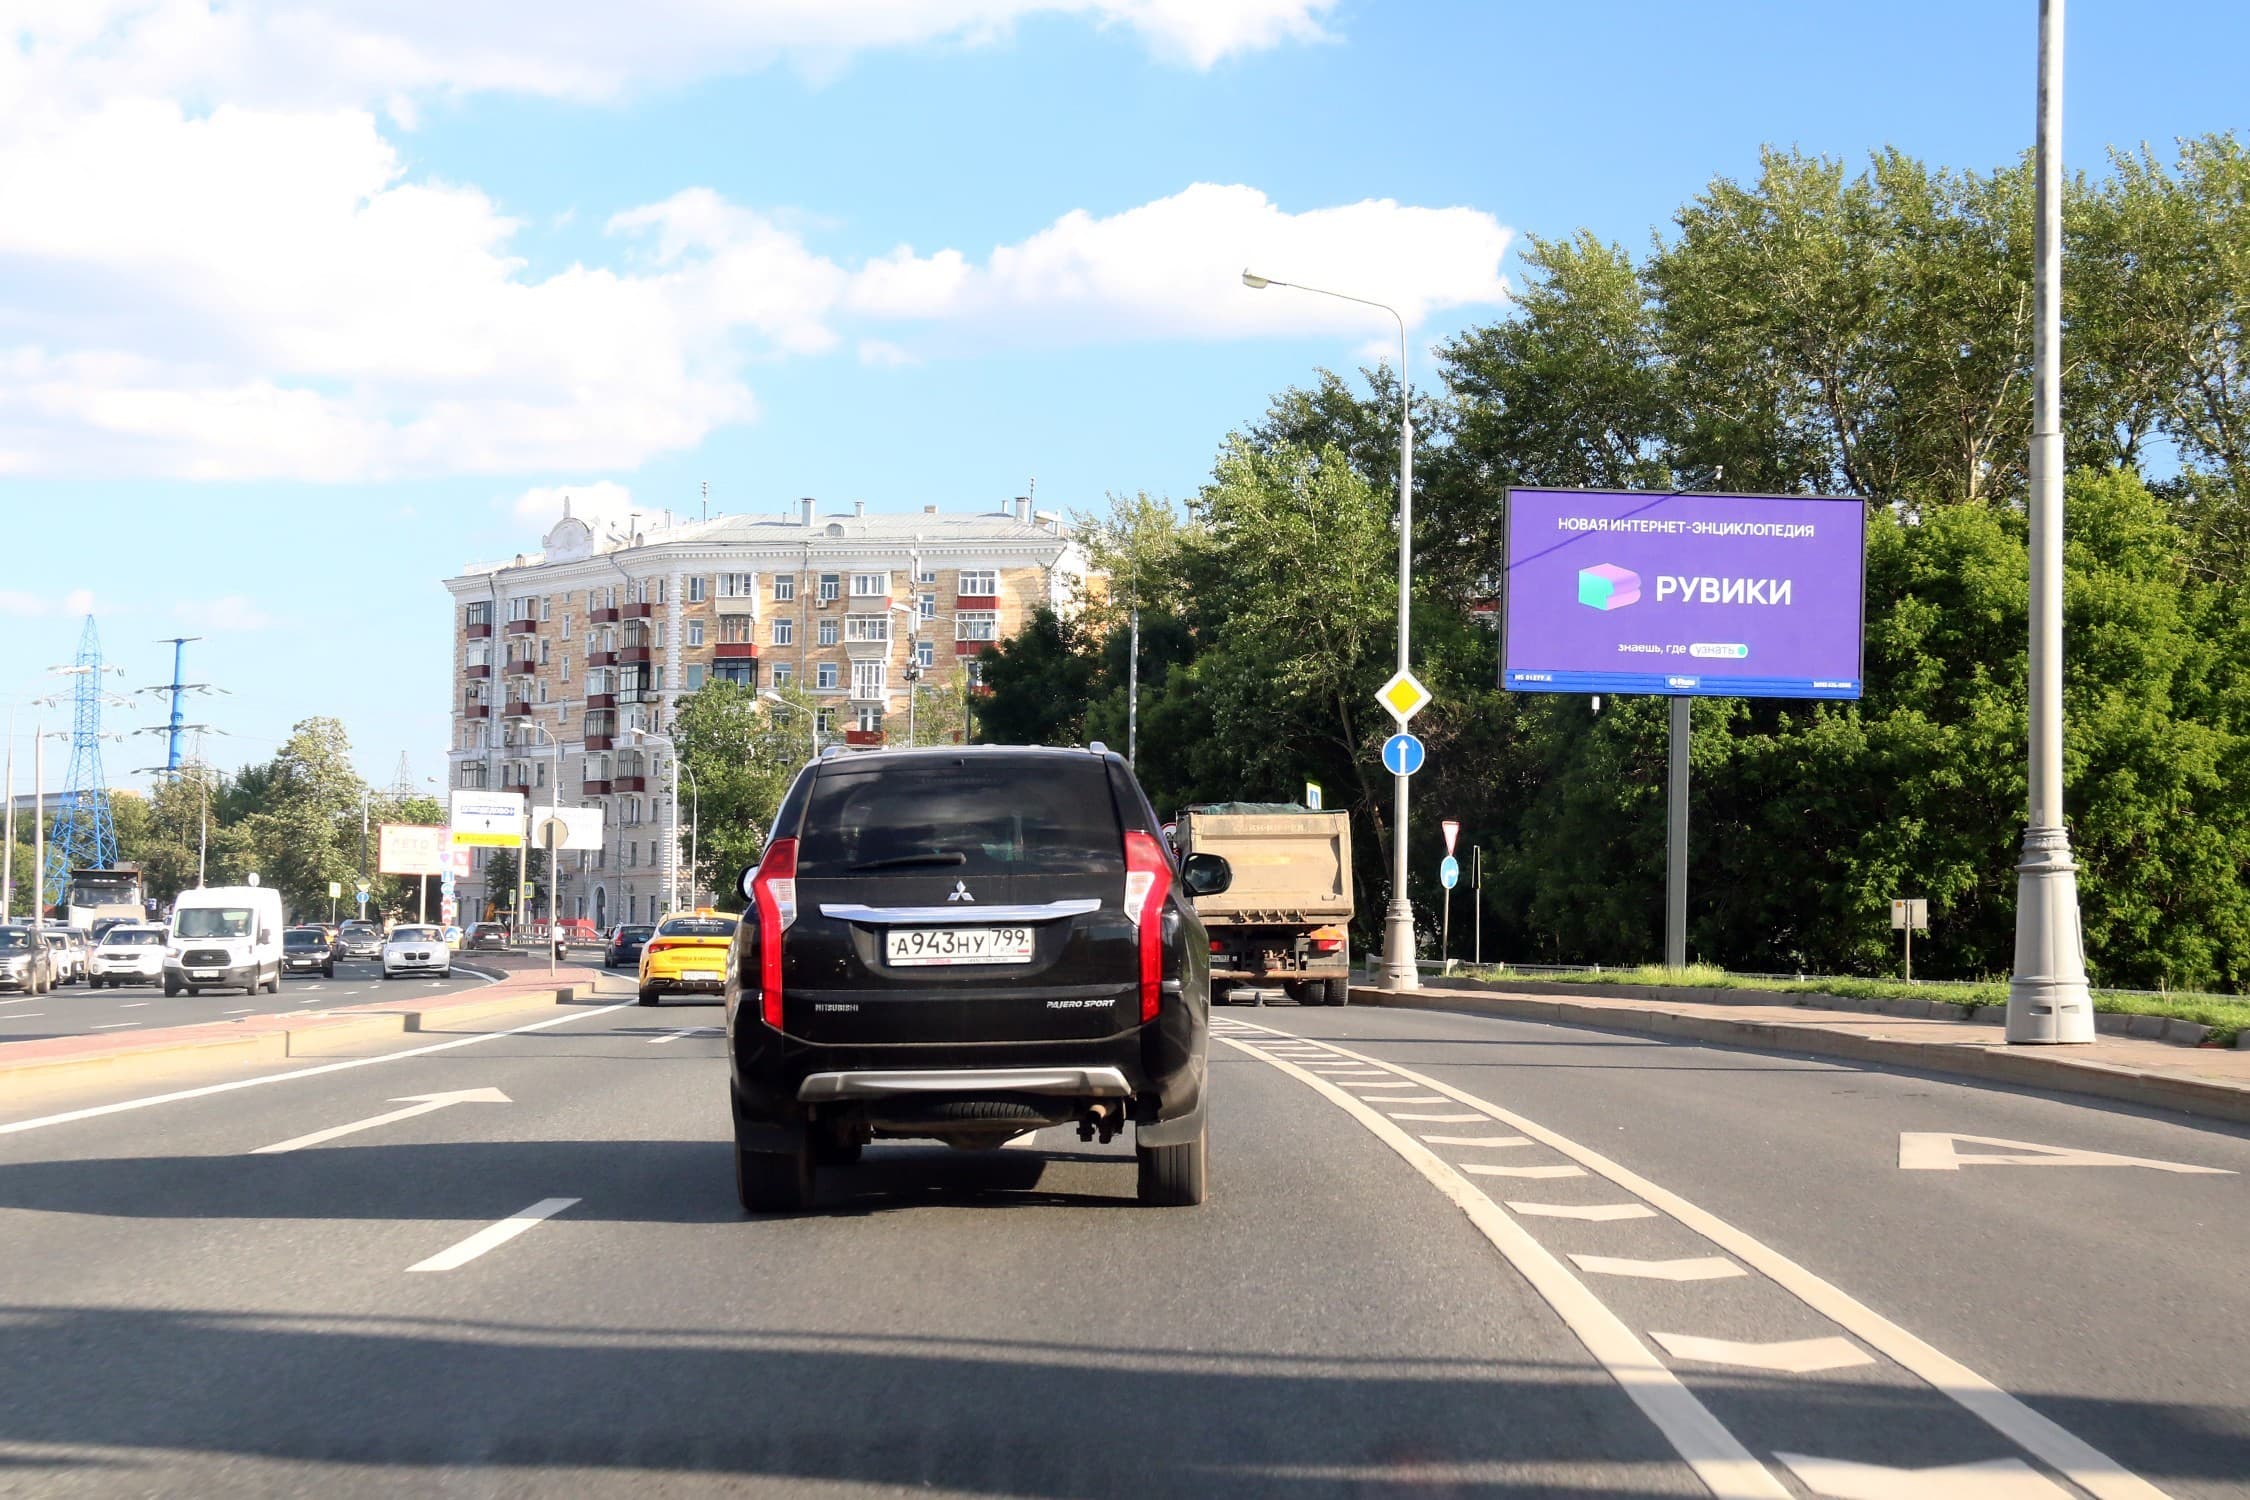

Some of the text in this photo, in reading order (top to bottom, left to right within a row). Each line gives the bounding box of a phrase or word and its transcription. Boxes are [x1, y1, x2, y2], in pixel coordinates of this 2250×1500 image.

[1558, 517, 1815, 539] НОВАЯ ИНТЕРНЕТ-ЭНЦИКЛОПЕДИЯ
[1656, 576, 1791, 605] РУВИКИ
[1617, 644, 1735, 656] знаешь, где узнать
[896, 929, 1025, 955] А943НУ 799
[1046, 1000, 1115, 1009] PAJERO SPORT
